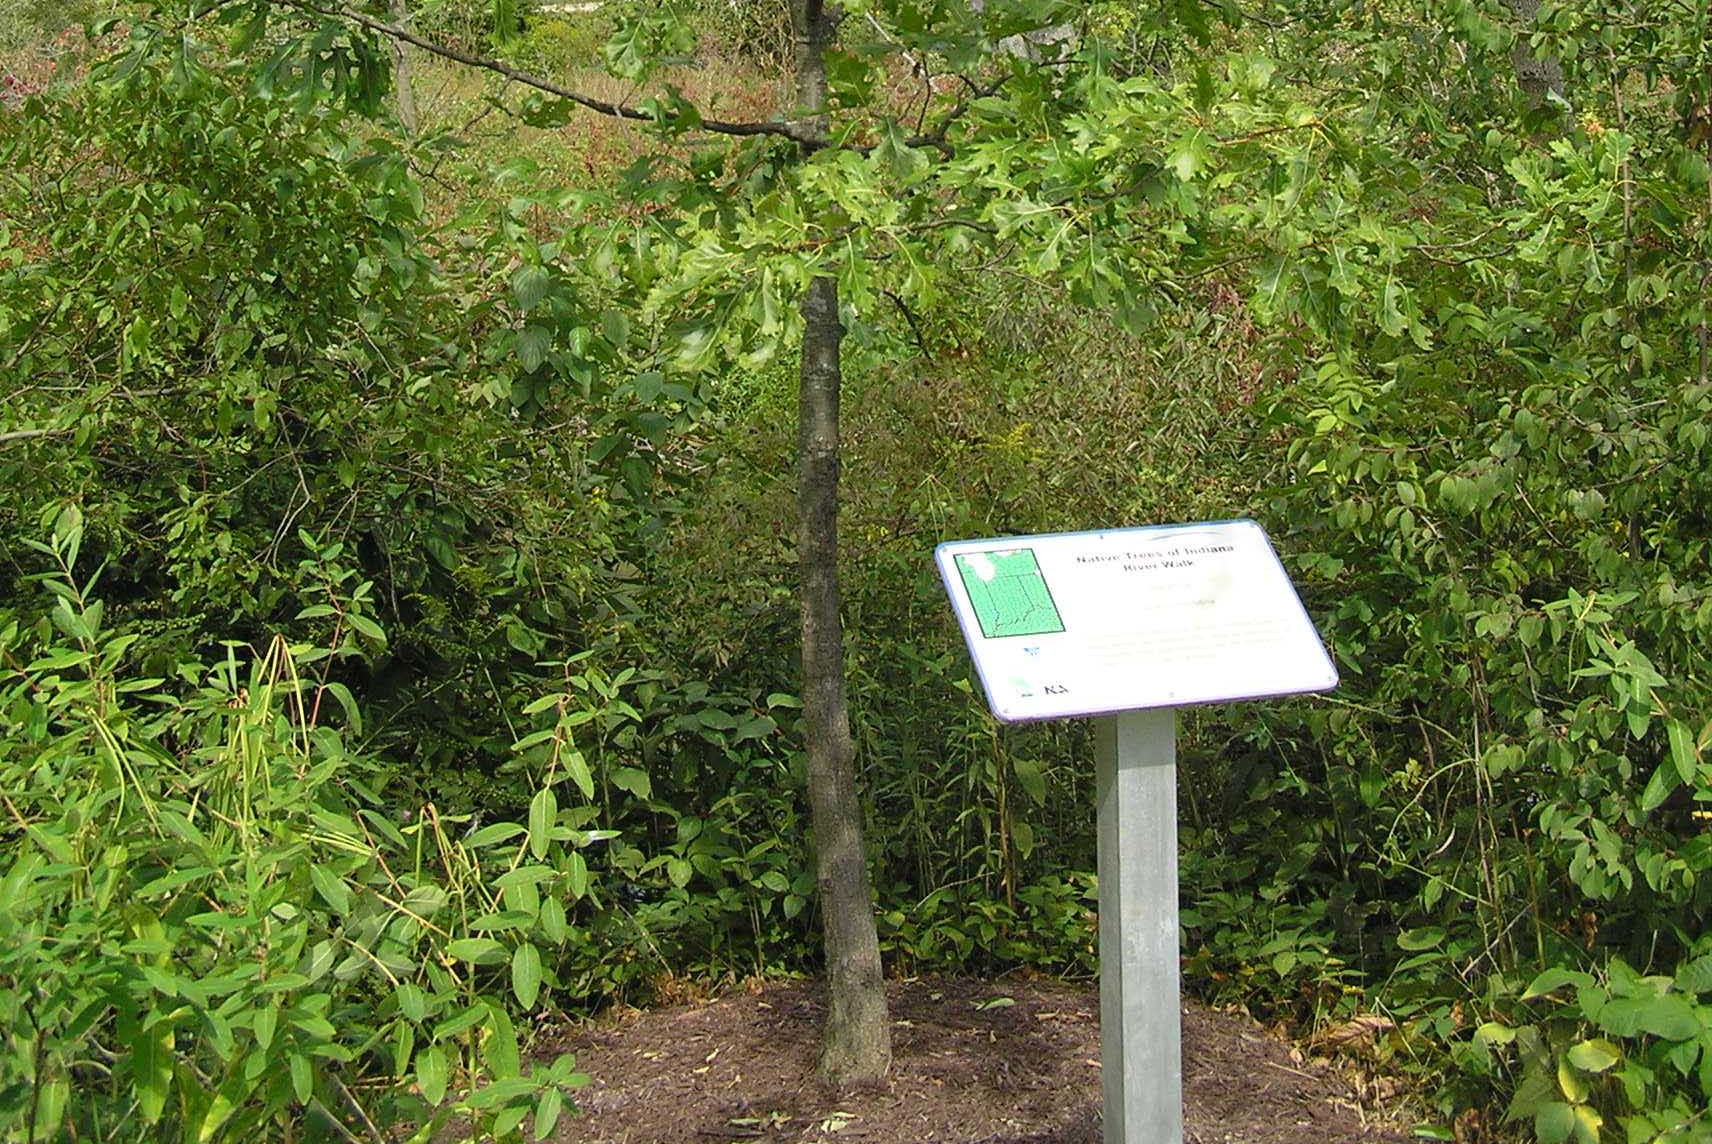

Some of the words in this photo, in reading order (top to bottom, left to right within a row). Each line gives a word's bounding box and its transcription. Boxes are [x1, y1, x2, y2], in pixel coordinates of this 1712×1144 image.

[1076, 553, 1120, 564] Native
[1126, 551, 1163, 561] Trees
[1168, 548, 1180, 557] of
[1184, 544, 1235, 556] Indiana
[1123, 563, 1158, 572] River
[1162, 559, 1195, 569] Walk
